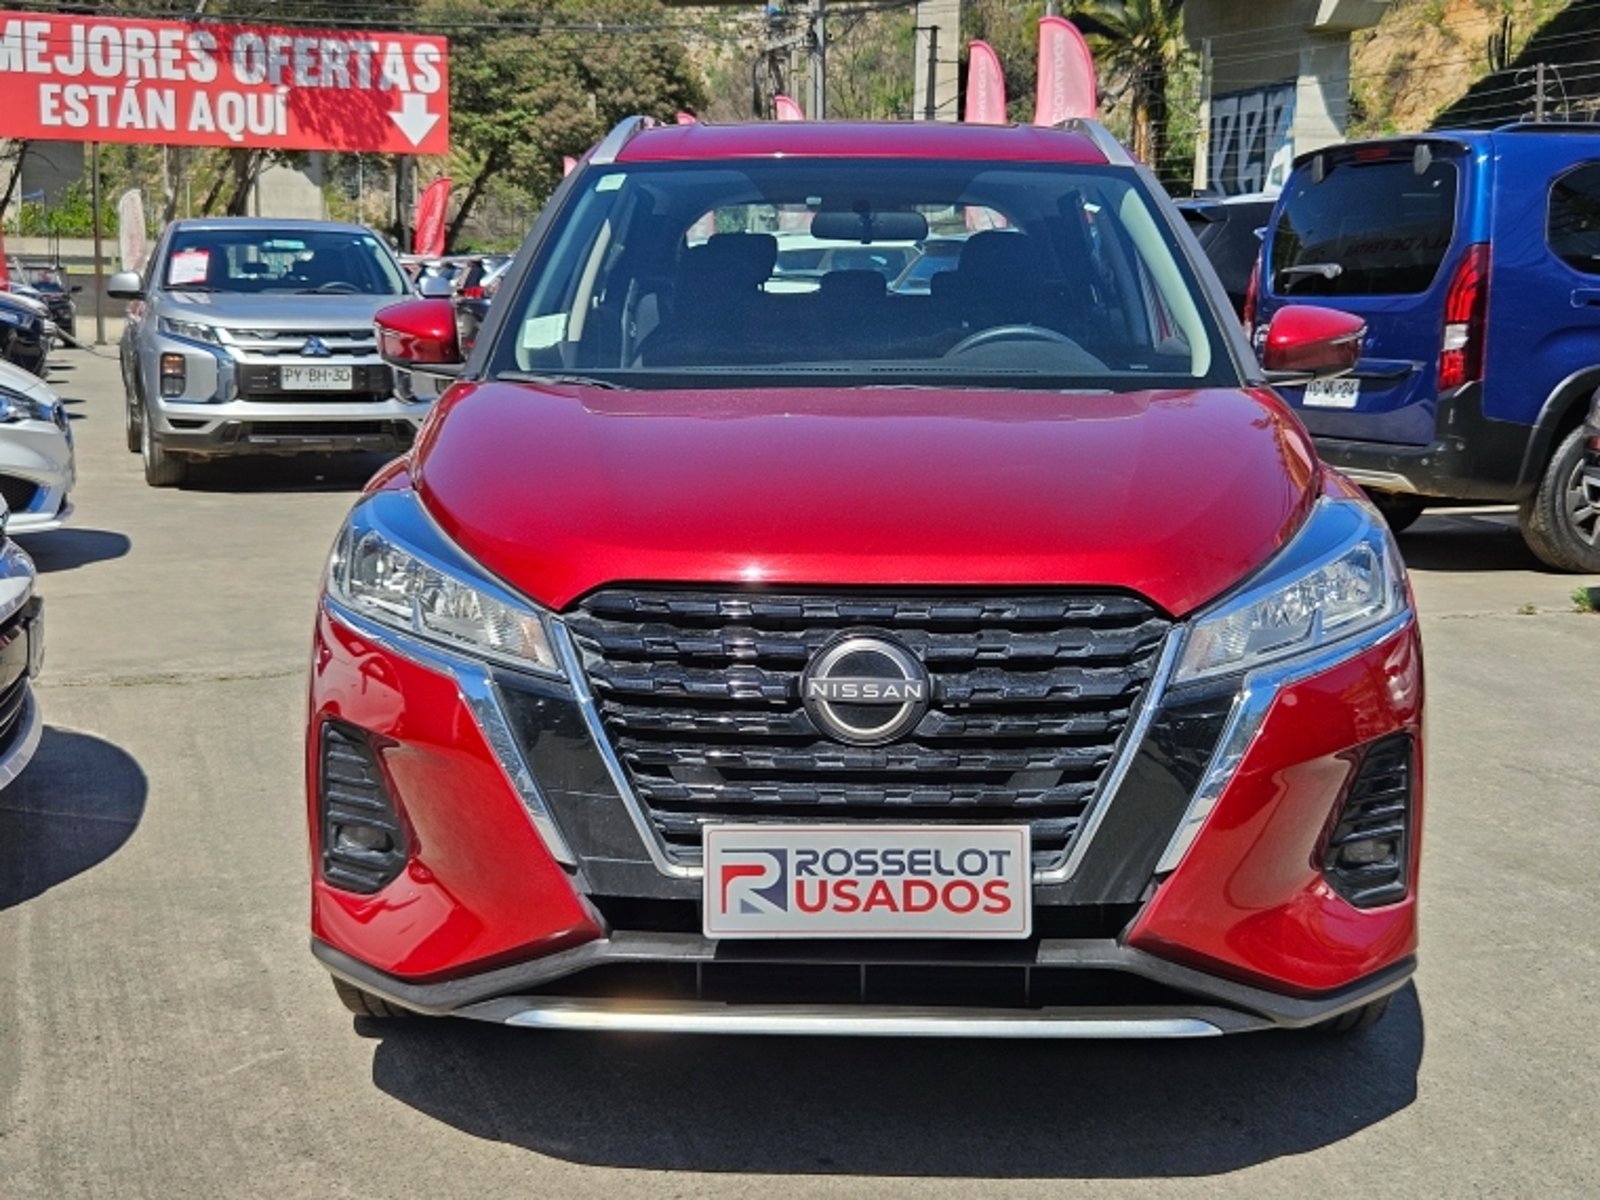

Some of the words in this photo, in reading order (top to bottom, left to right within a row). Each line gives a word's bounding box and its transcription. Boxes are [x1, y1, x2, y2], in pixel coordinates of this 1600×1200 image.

[0, 19, 219, 83] MEJORES
[232, 32, 442, 94] OFERTAS
[39, 79, 177, 131] ESTÁN
[187, 85, 290, 142] AQUÍ
[809, 682, 921, 698] NISSAN
[795, 849, 1011, 876] ROSSELOT
[795, 879, 1012, 914] USADOS
